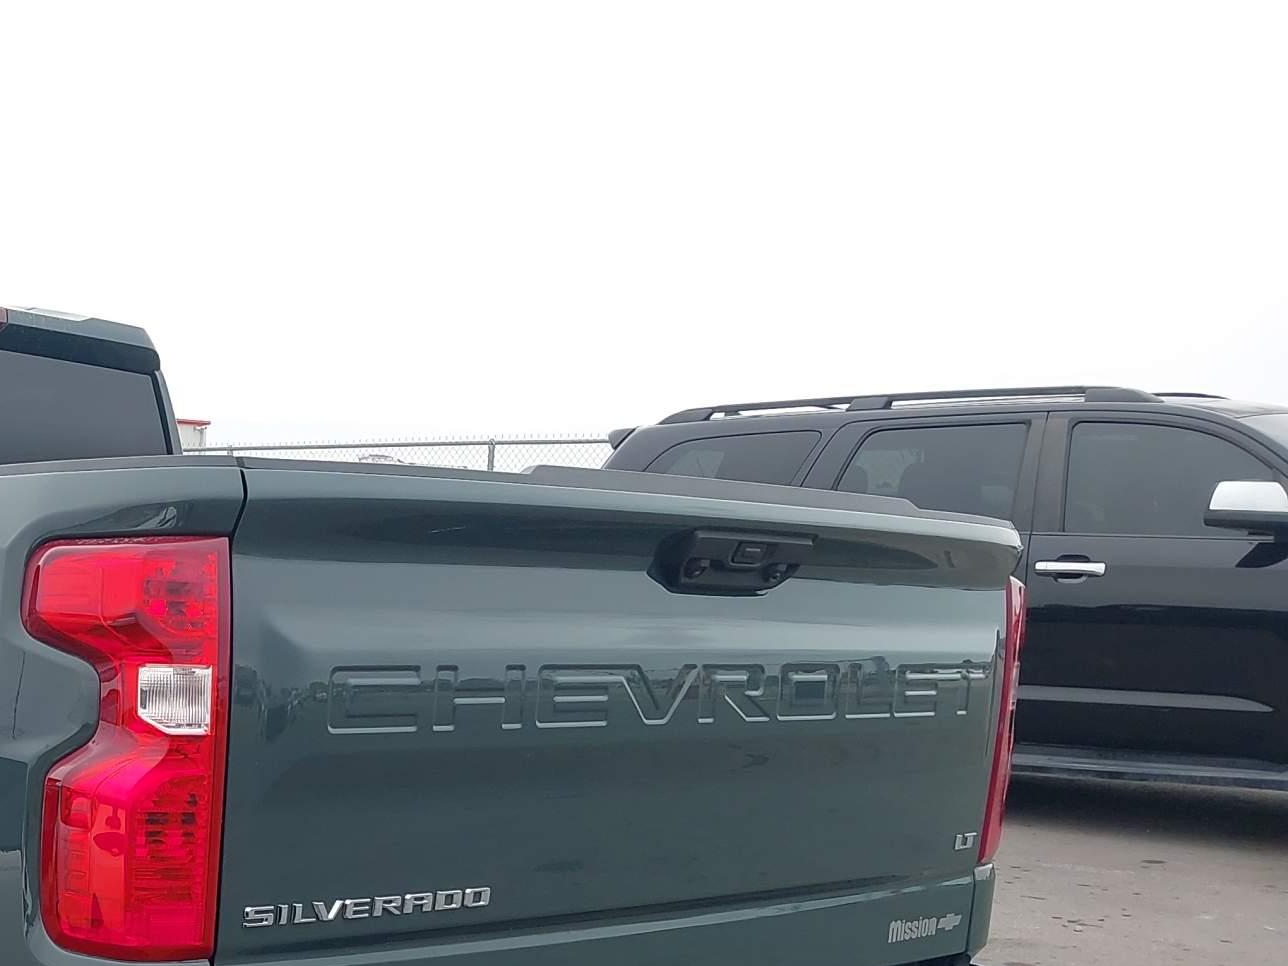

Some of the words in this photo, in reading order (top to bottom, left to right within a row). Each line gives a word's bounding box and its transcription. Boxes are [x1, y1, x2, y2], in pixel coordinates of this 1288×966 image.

[328, 662, 988, 734] CHEVROLET
[954, 832, 978, 850] LT
[242, 886, 492, 928] SILVERADO
